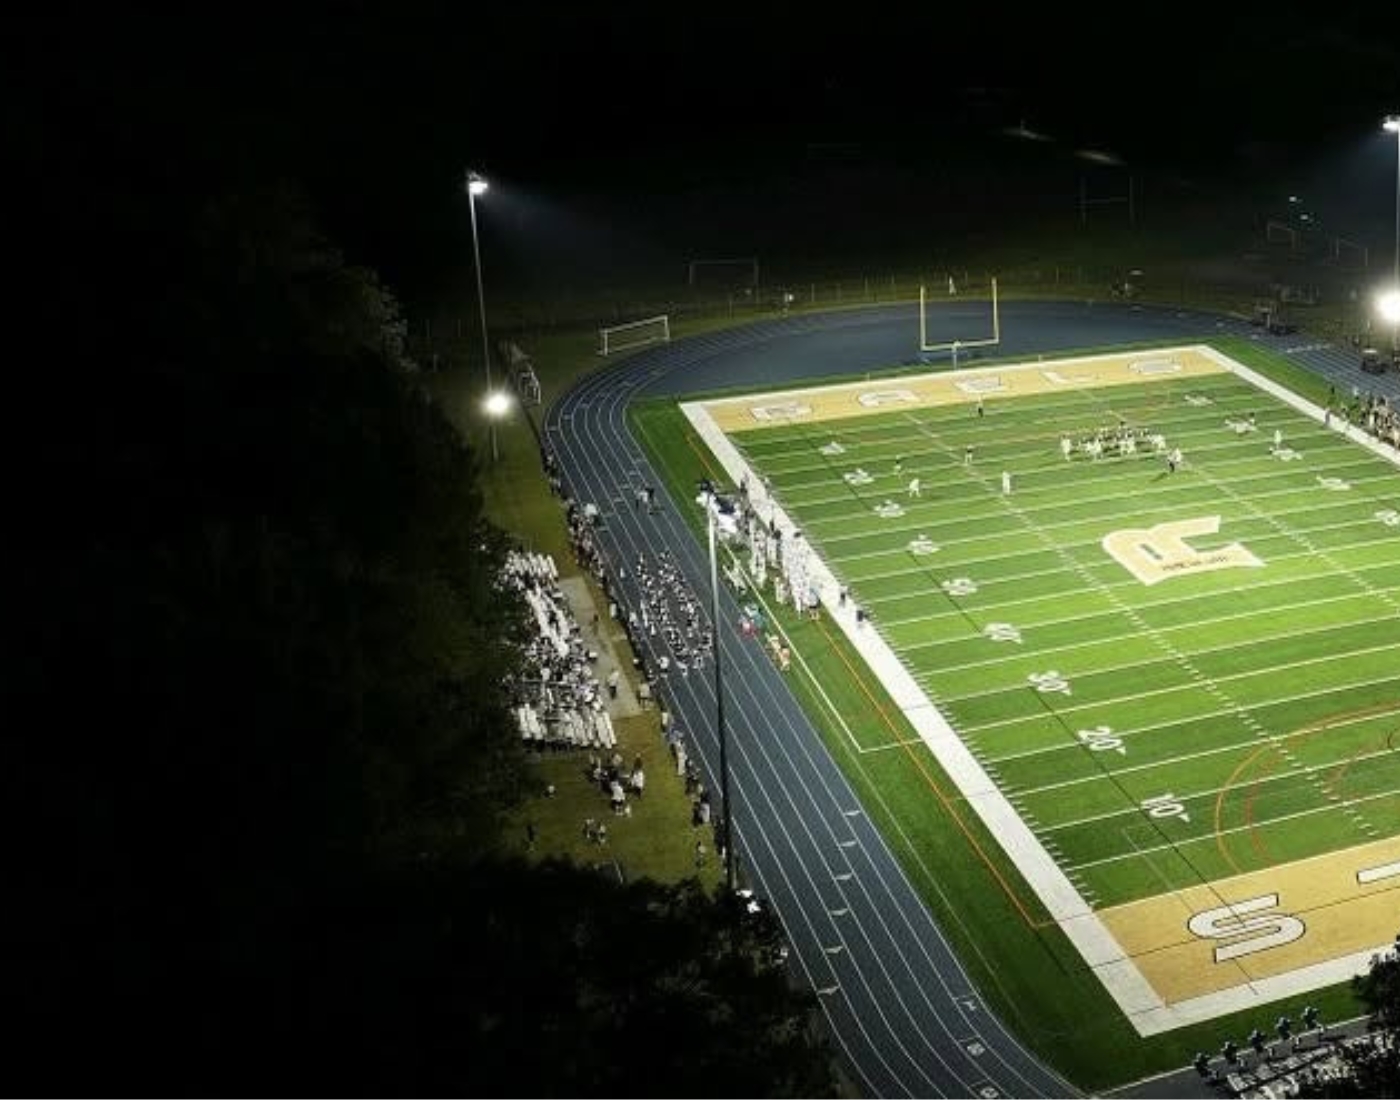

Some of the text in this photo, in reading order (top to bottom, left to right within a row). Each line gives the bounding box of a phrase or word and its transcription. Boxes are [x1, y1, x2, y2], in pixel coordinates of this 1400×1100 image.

[1101, 514, 1267, 586] R
[1078, 726, 1123, 751] 20
[1139, 793, 1185, 818] 10
